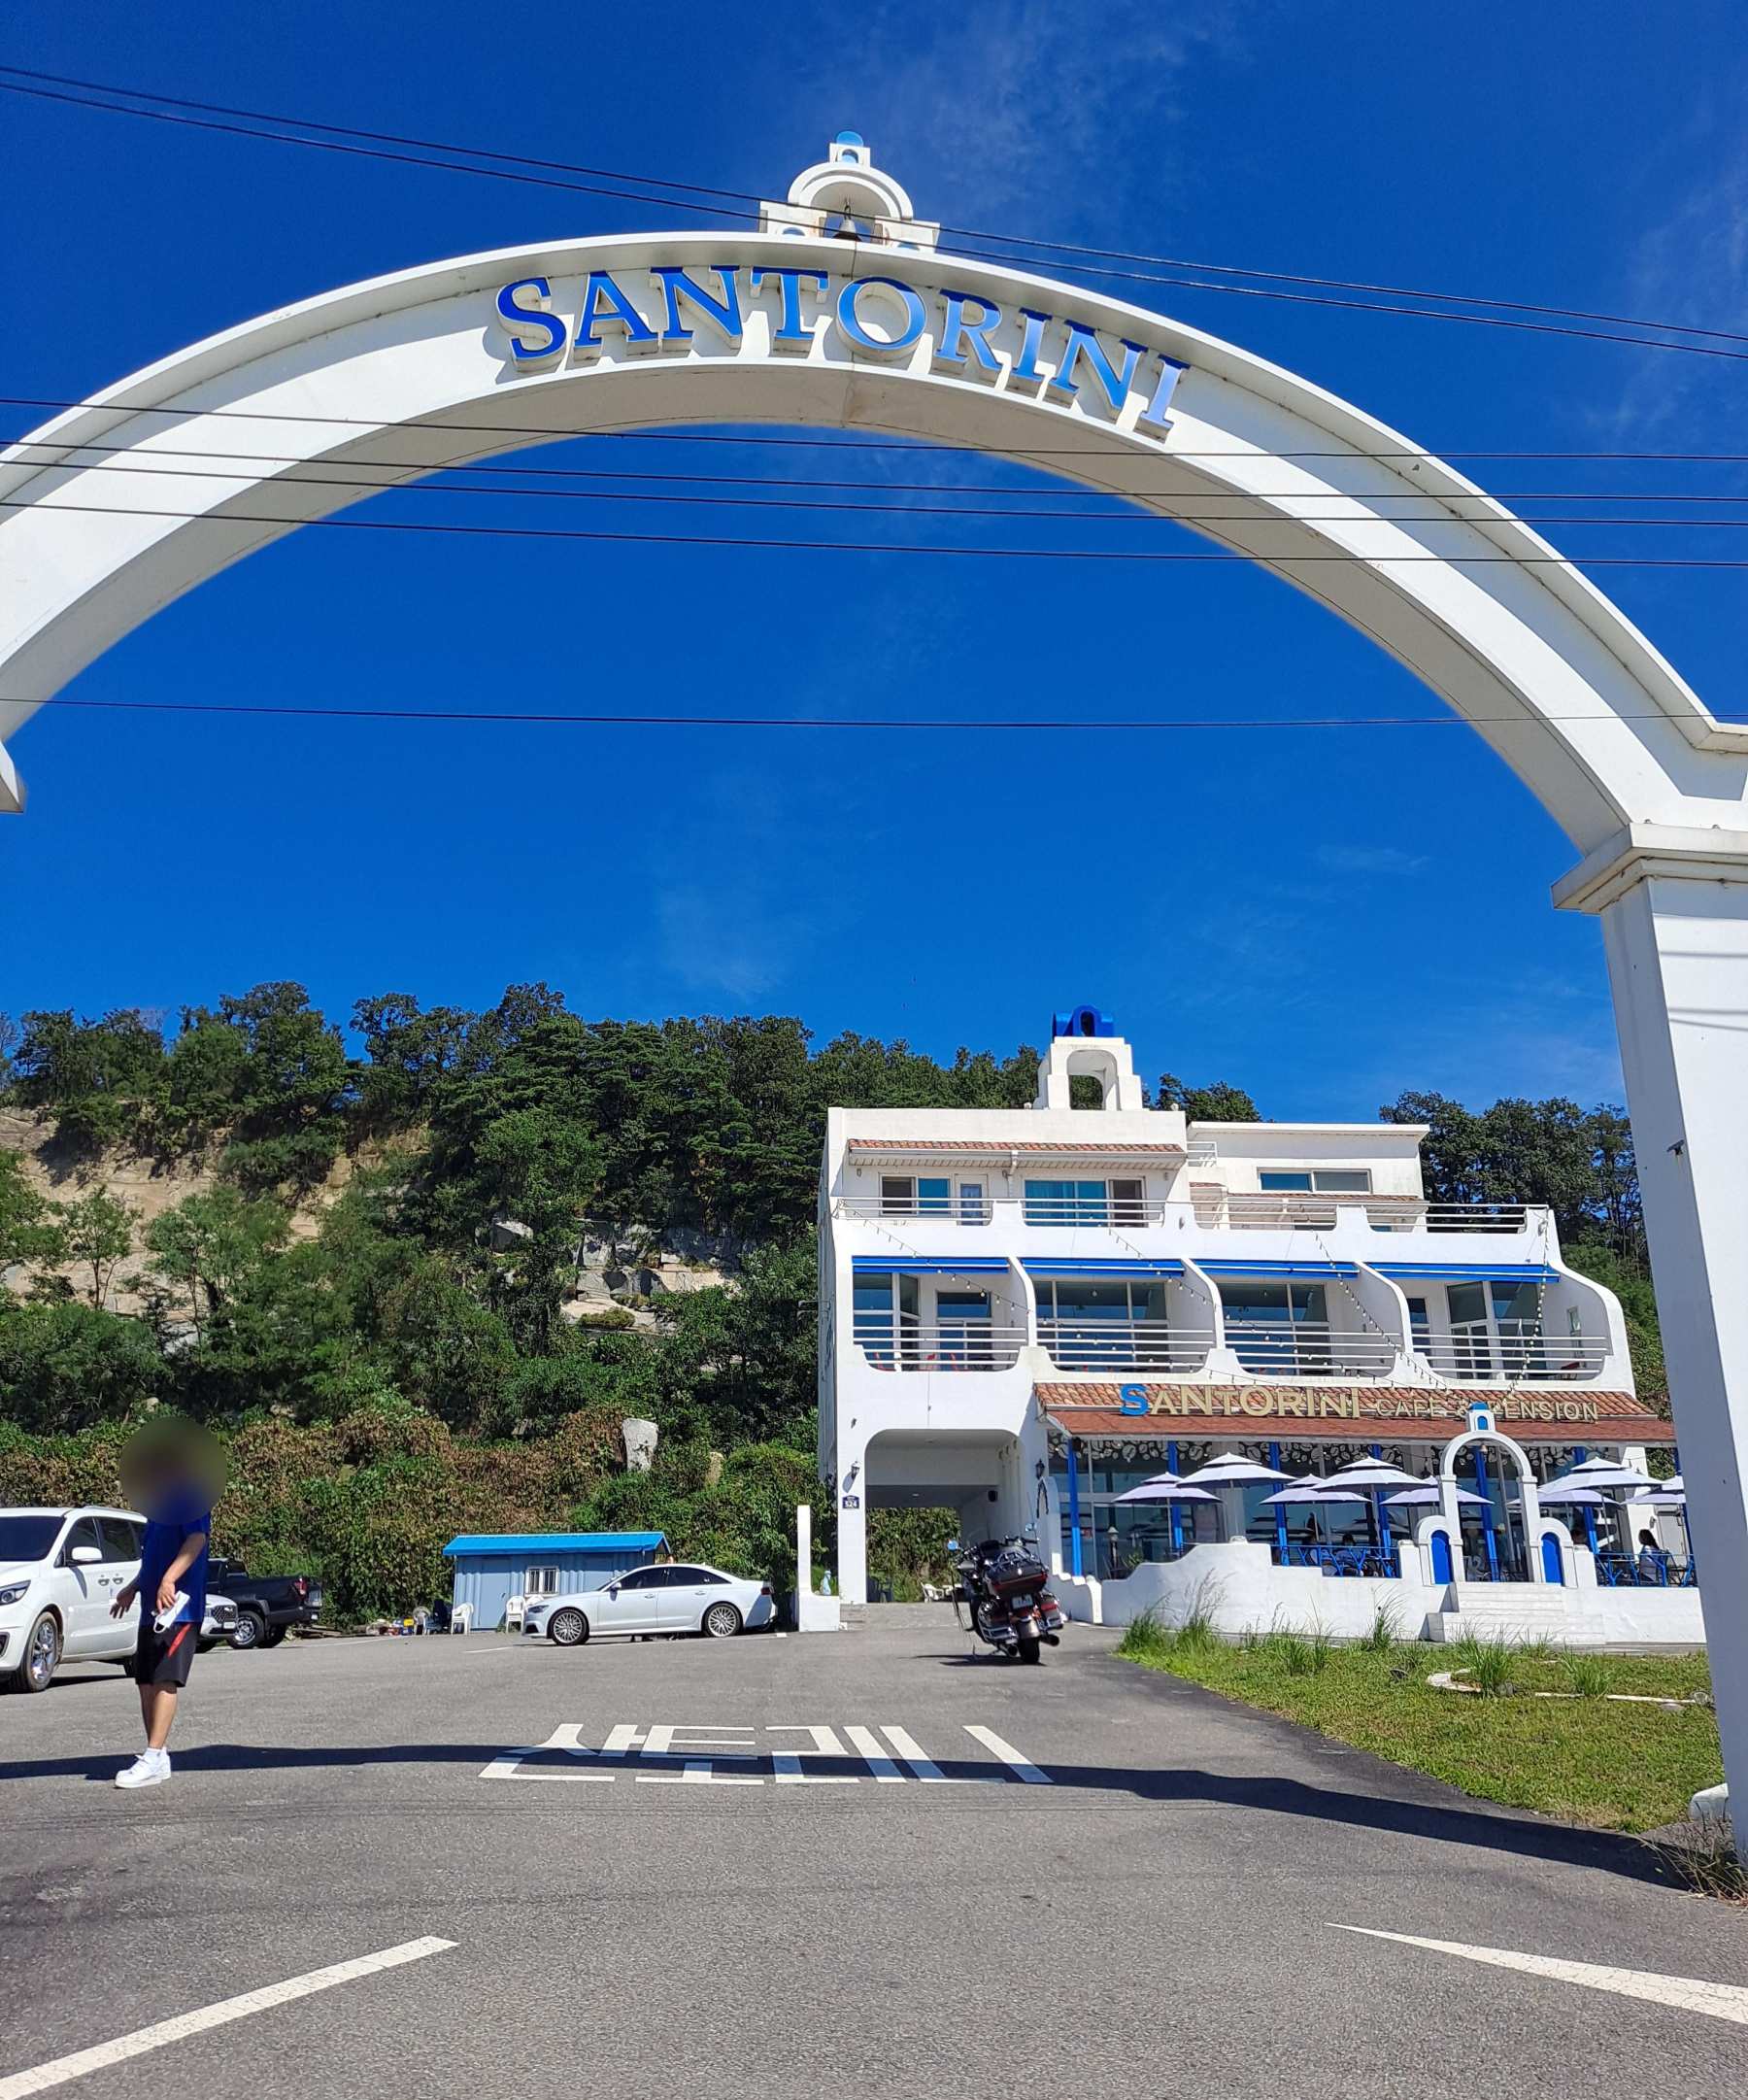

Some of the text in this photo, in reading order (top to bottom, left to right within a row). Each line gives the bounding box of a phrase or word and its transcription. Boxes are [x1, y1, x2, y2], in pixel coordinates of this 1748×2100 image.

[495, 265, 1191, 435] SANTORINI
[1119, 1383, 1360, 1419] SANTORINI
[479, 1724, 1056, 1785] 산토리니
